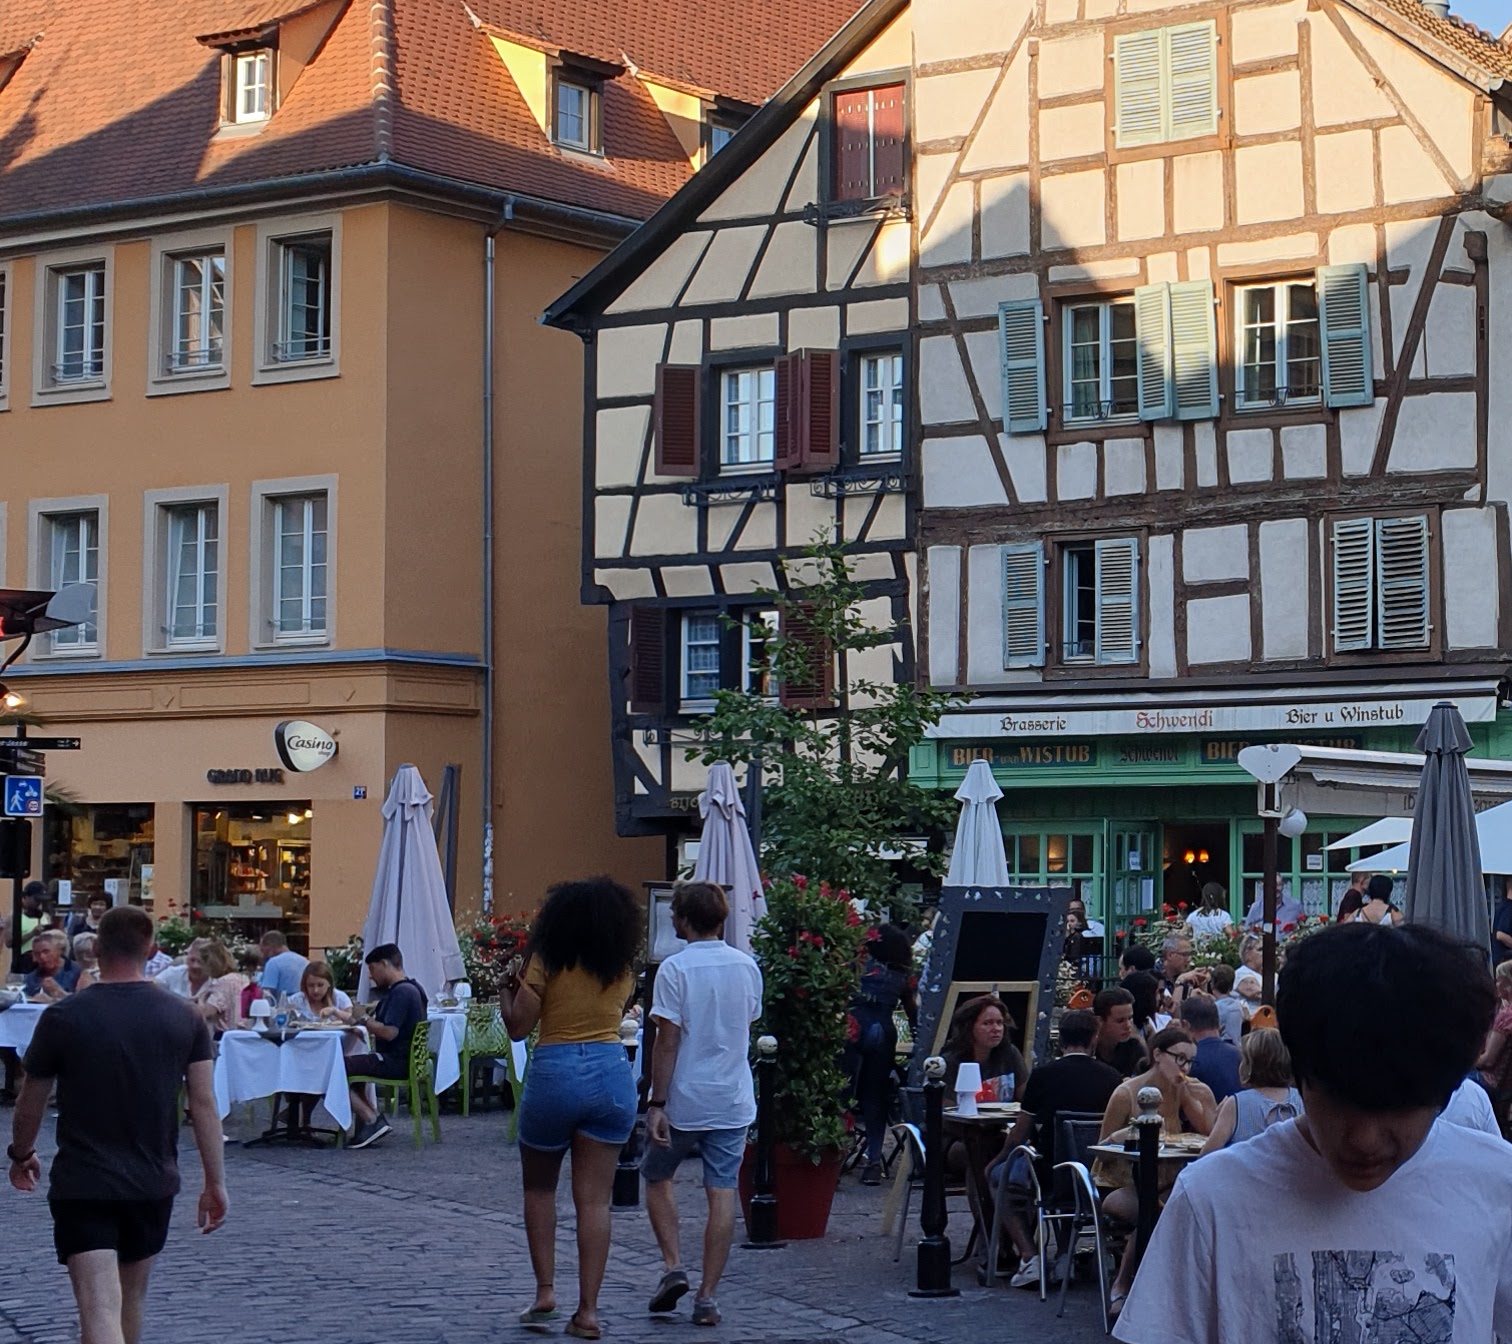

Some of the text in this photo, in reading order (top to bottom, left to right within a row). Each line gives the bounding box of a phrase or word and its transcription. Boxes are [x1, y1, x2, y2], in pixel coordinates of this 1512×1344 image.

[1000, 704, 1404, 731] Brasserie Schwendi Bier u Winstub
[287, 736, 333, 751] Casino
[1020, 745, 1090, 764] WISTUB
